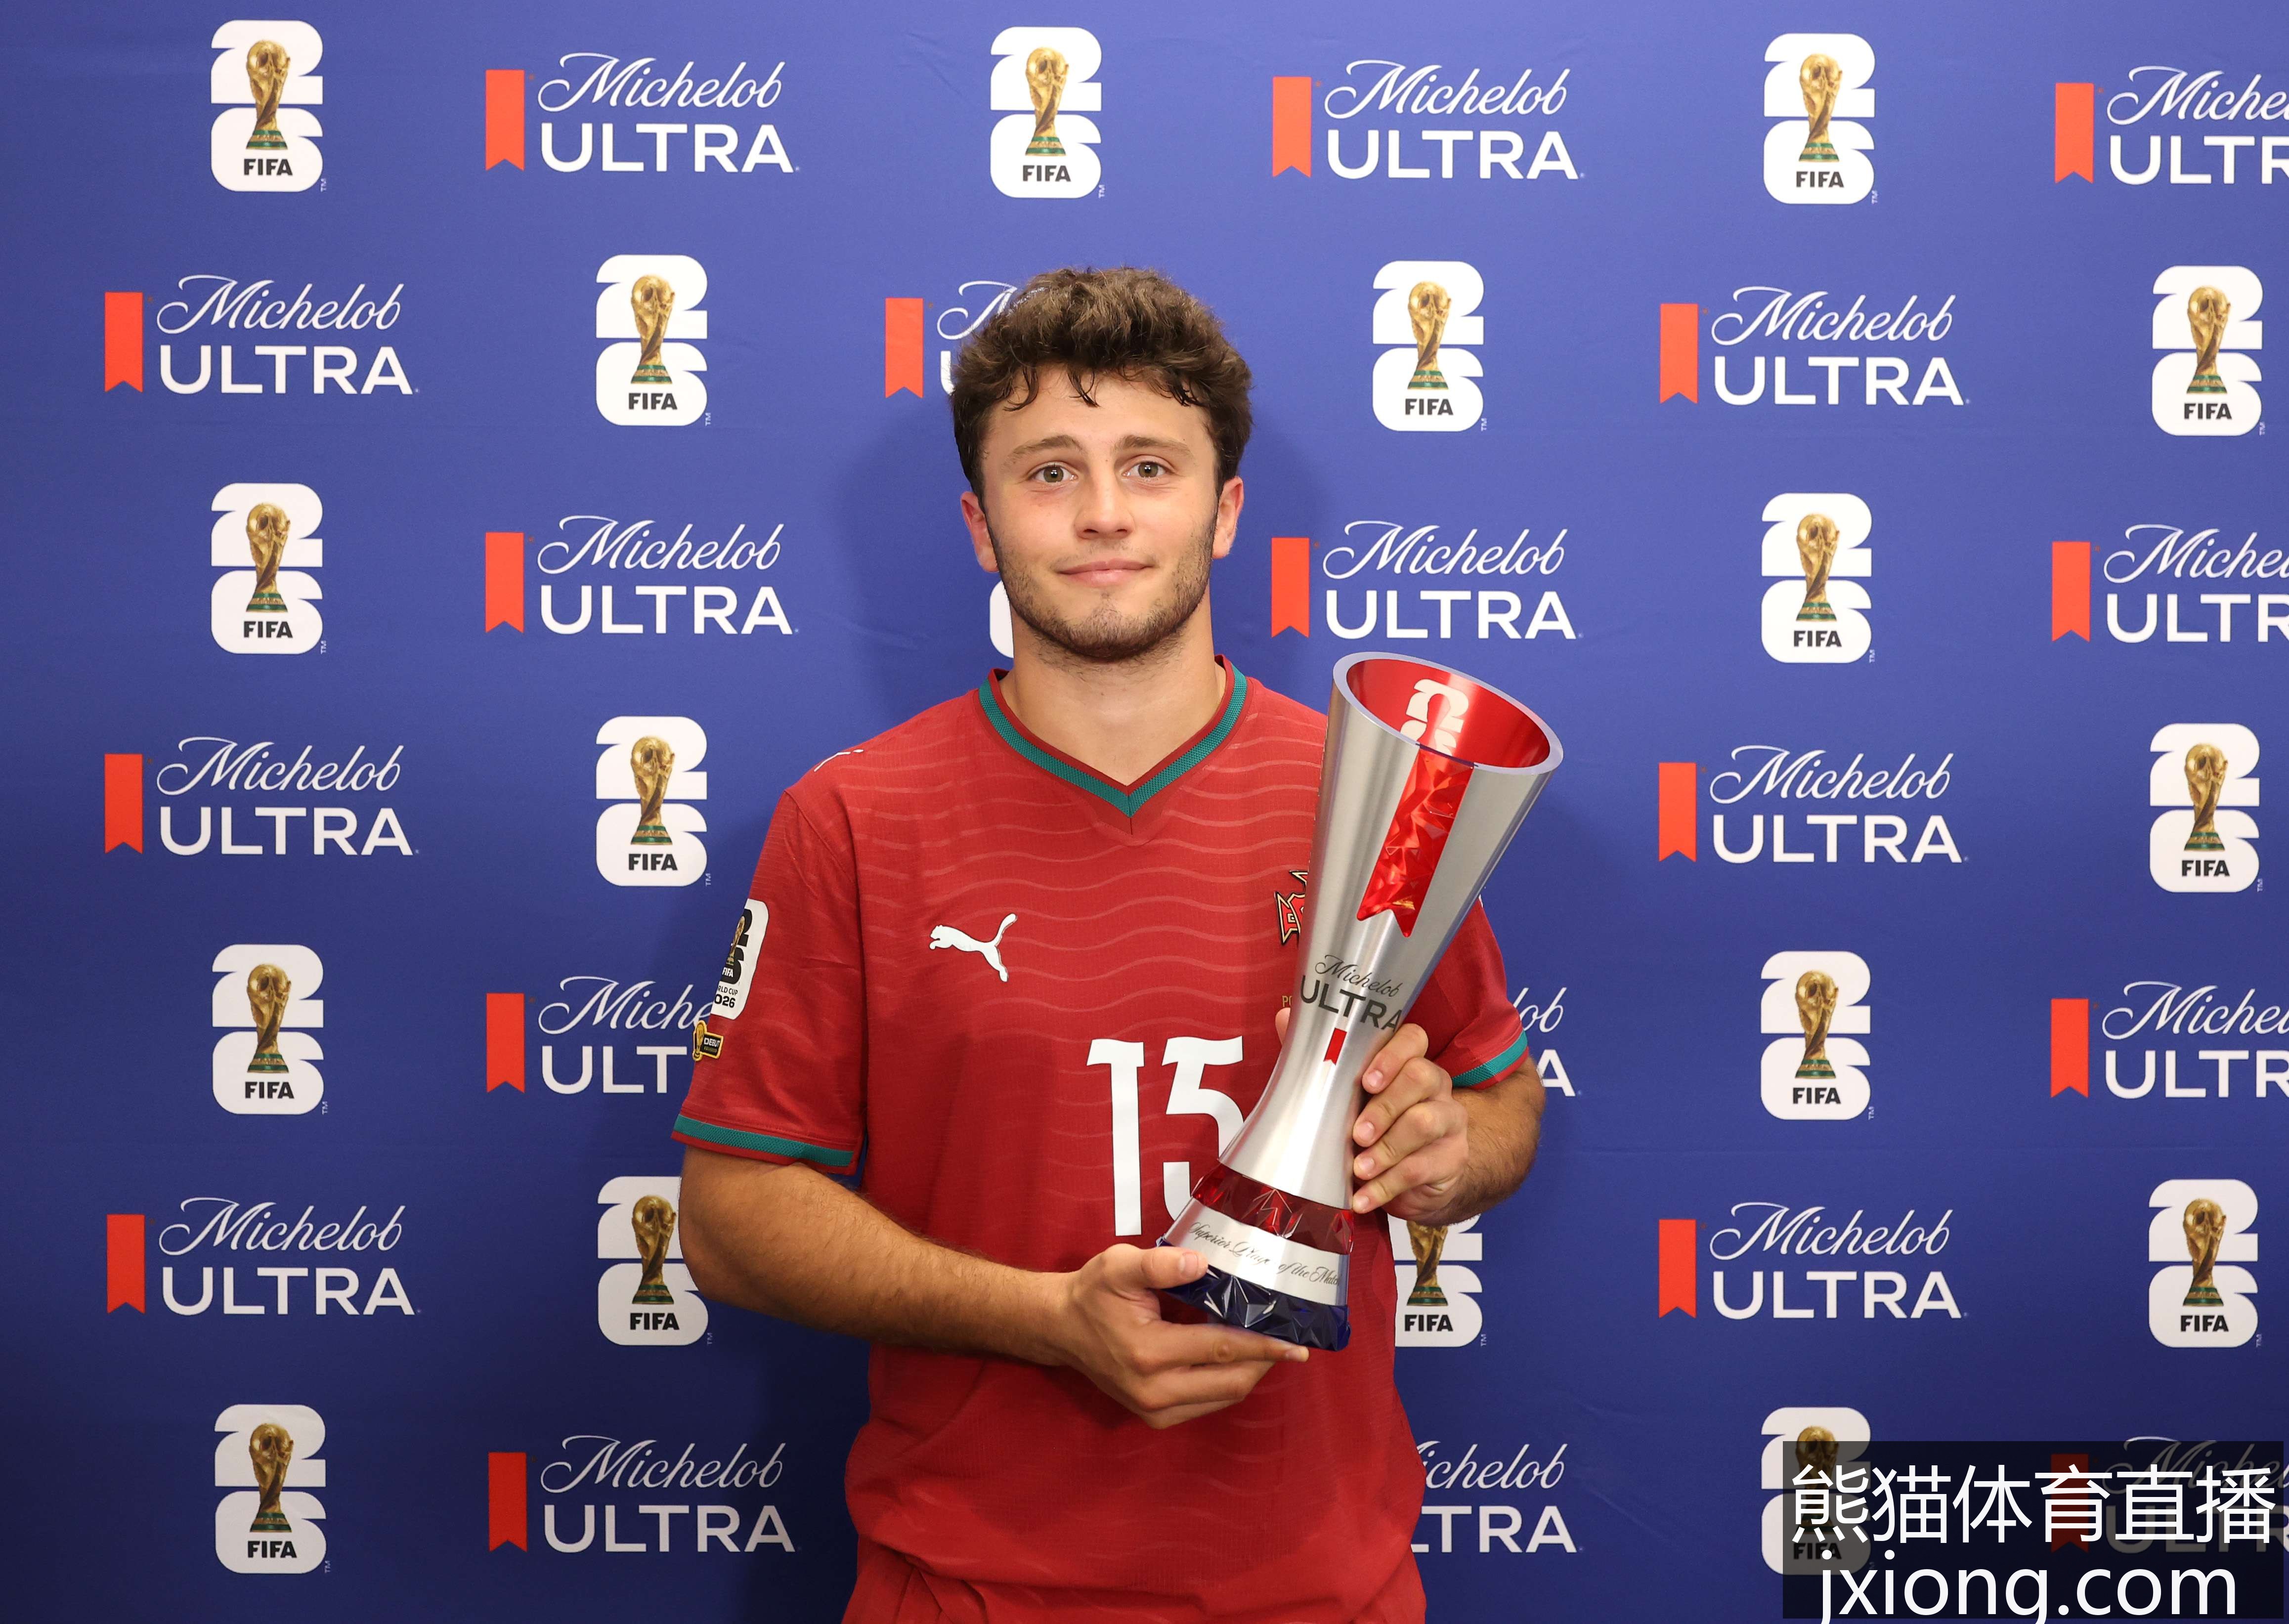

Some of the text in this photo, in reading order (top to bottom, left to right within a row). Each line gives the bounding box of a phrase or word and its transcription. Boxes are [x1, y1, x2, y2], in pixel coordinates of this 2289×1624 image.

[538, 53, 785, 112] Michelob
[1324, 60, 1570, 119] Michelob
[245, 159, 292, 175] FIFA
[542, 123, 794, 173] ULTRA
[1328, 129, 1579, 180] ULTRA
[1024, 166, 1070, 180] FIFA
[1797, 172, 1843, 186] FIFA
[158, 275, 404, 334] Michelob
[1711, 287, 1956, 345] Michelob
[161, 345, 413, 395] ULTRA
[1715, 356, 1964, 406] ULTRA
[629, 393, 677, 409] FIFA
[1406, 399, 1452, 414] FIFA
[2185, 404, 2231, 419] FIFA
[538, 516, 784, 574] Michelob
[1324, 521, 1568, 580] Michelob
[244, 622, 292, 638] FIFA
[541, 586, 793, 635] ULTRA
[1327, 591, 1576, 640] ULTRA
[1794, 631, 1841, 646] FIFA
[158, 737, 404, 796] Michelob
[1711, 746, 1954, 804] Michelob
[161, 807, 413, 856] ULTRA
[1714, 815, 1962, 864] ULTRA
[629, 854, 677, 870] FIFA
[2182, 860, 2229, 876] FIFA
[722, 967, 734, 978] FIFA
[729, 987, 738, 996] CUP
[1315, 954, 1403, 997] Michelob
[1300, 975, 1402, 1033] ULTRA
[703, 1037, 721, 1047] DEBUT
[246, 1082, 294, 1098] FIFA
[1793, 1088, 1840, 1103] FIFA
[1086, 1036, 1244, 1236] 15
[160, 1198, 405, 1256] Michelob
[1189, 1222, 1231, 1249] Superior
[1291, 1265, 1310, 1278] the
[1711, 1203, 1953, 1260] Michelob
[164, 1268, 415, 1316] ULTRA
[1714, 1272, 1962, 1320] ULTRA
[630, 1313, 679, 1330] FIFA
[1405, 1315, 1453, 1331] FIFA
[2181, 1316, 2228, 1331] FIFA
[541, 1436, 785, 1493] Michelob
[248, 1541, 297, 1558] FIFA
[545, 1505, 795, 1553] ULTRA
